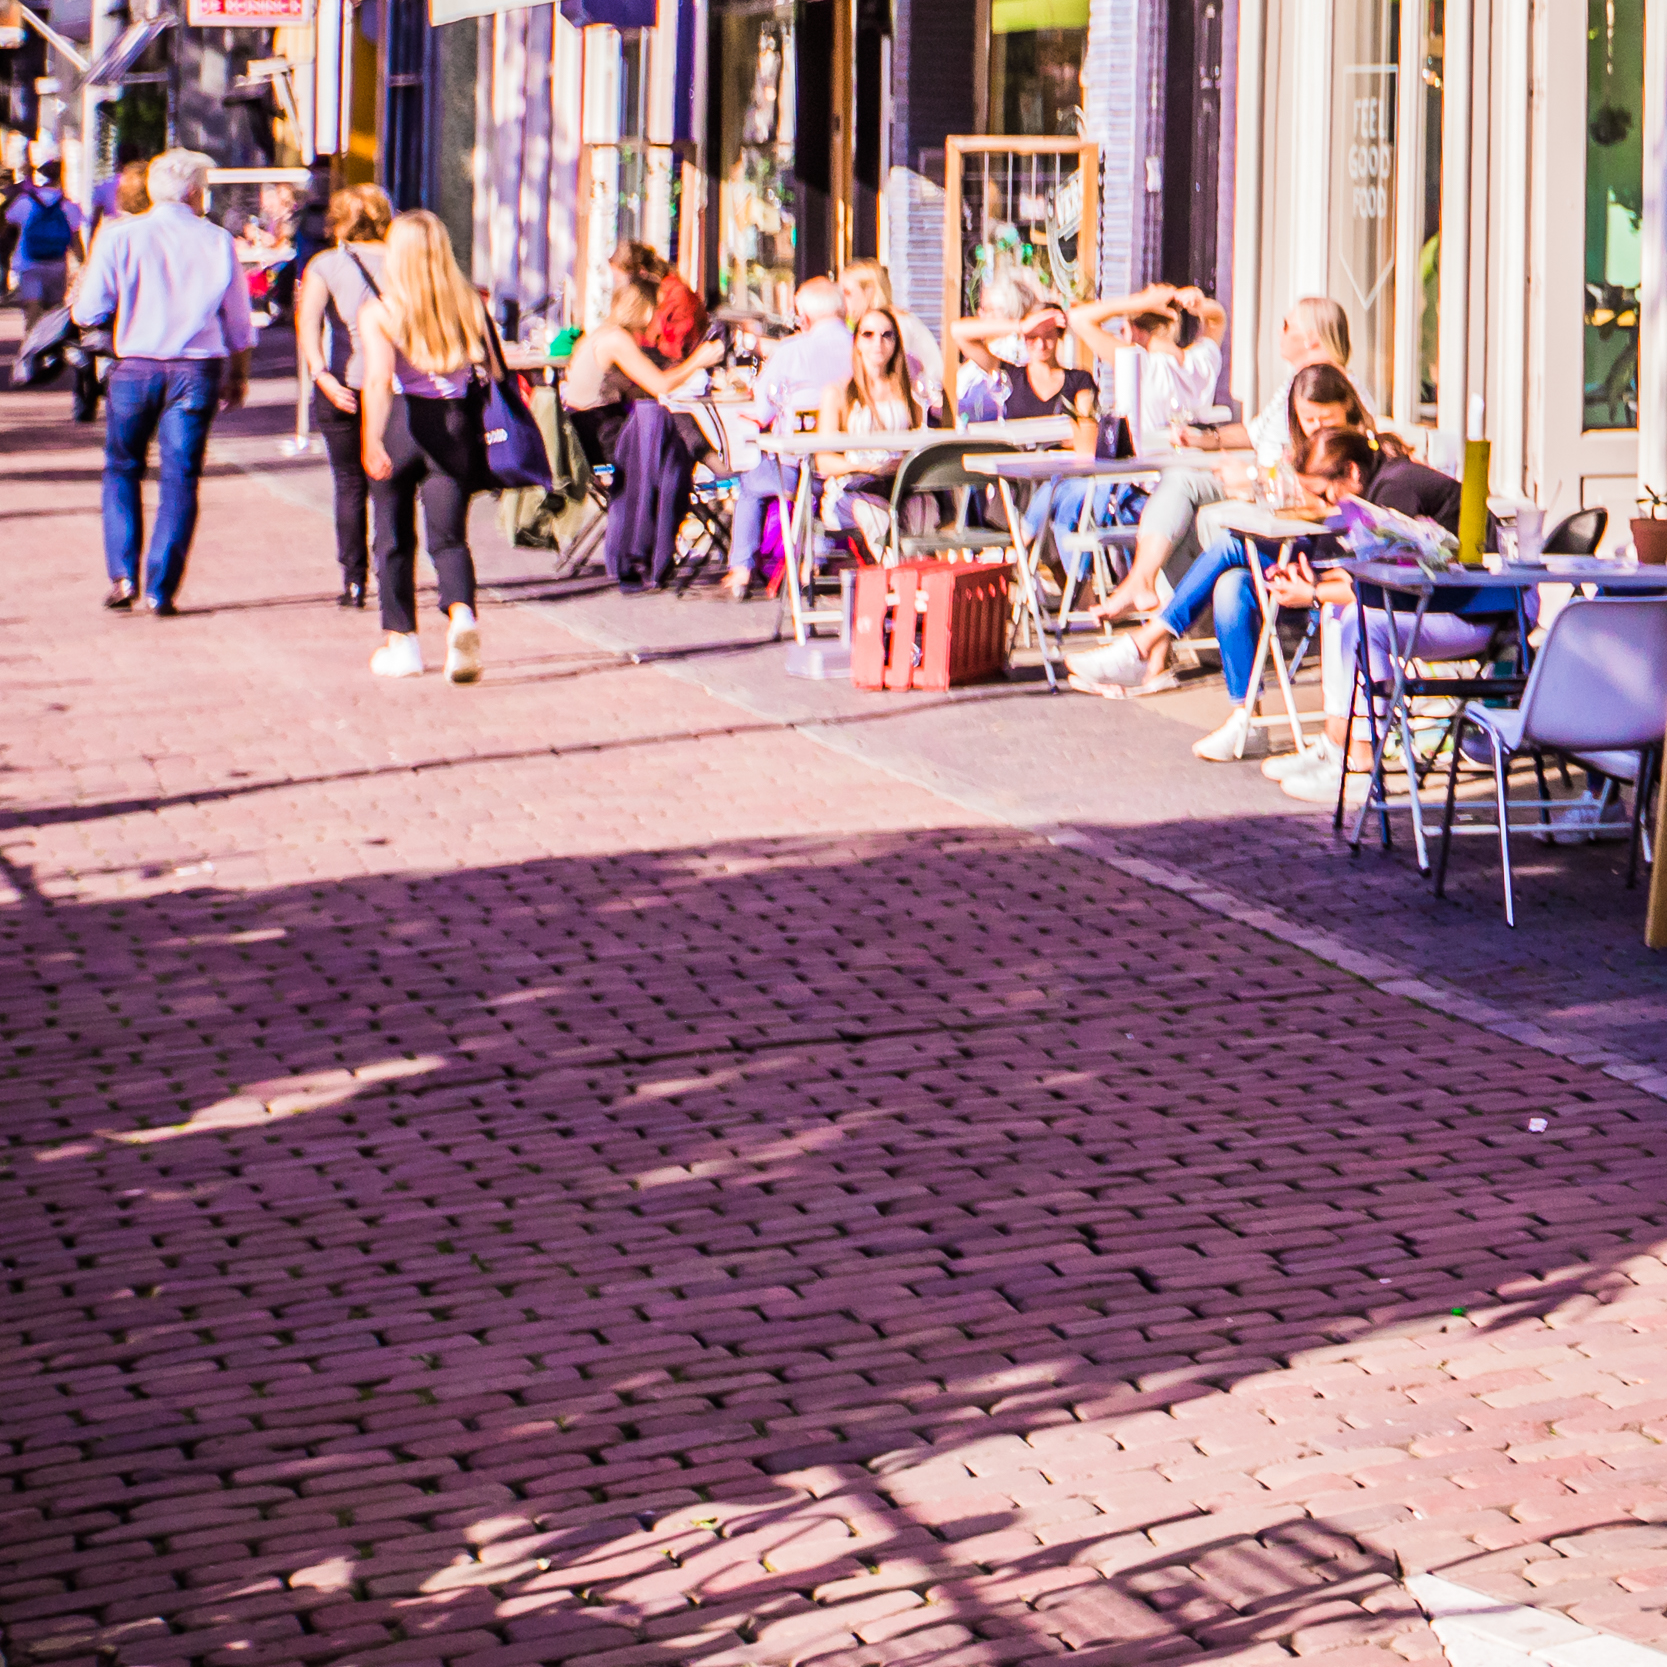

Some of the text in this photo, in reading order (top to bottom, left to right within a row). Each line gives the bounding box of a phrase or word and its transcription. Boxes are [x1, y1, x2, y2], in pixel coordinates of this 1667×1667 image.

[1353, 97, 1387, 138] FEEL
[1348, 144, 1390, 179] GOOD
[1353, 187, 1387, 219] FOOD
